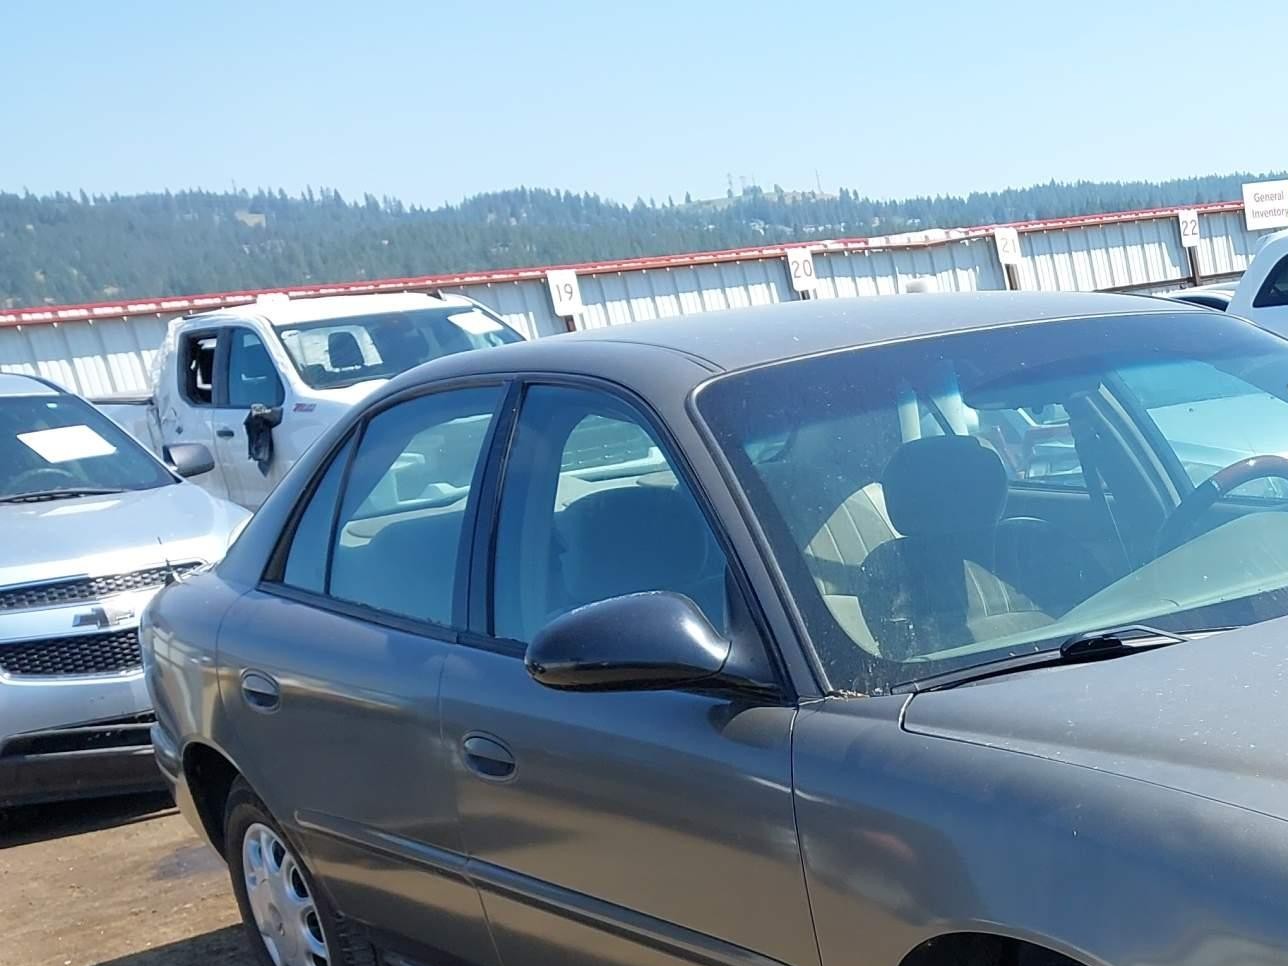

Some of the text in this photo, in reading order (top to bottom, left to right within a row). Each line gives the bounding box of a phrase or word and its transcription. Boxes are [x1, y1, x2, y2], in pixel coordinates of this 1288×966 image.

[1253, 189, 1285, 203] General
[1181, 219, 1199, 237] 22
[1000, 237, 1017, 254] 21
[791, 259, 813, 279] 20
[555, 283, 574, 302] 19
